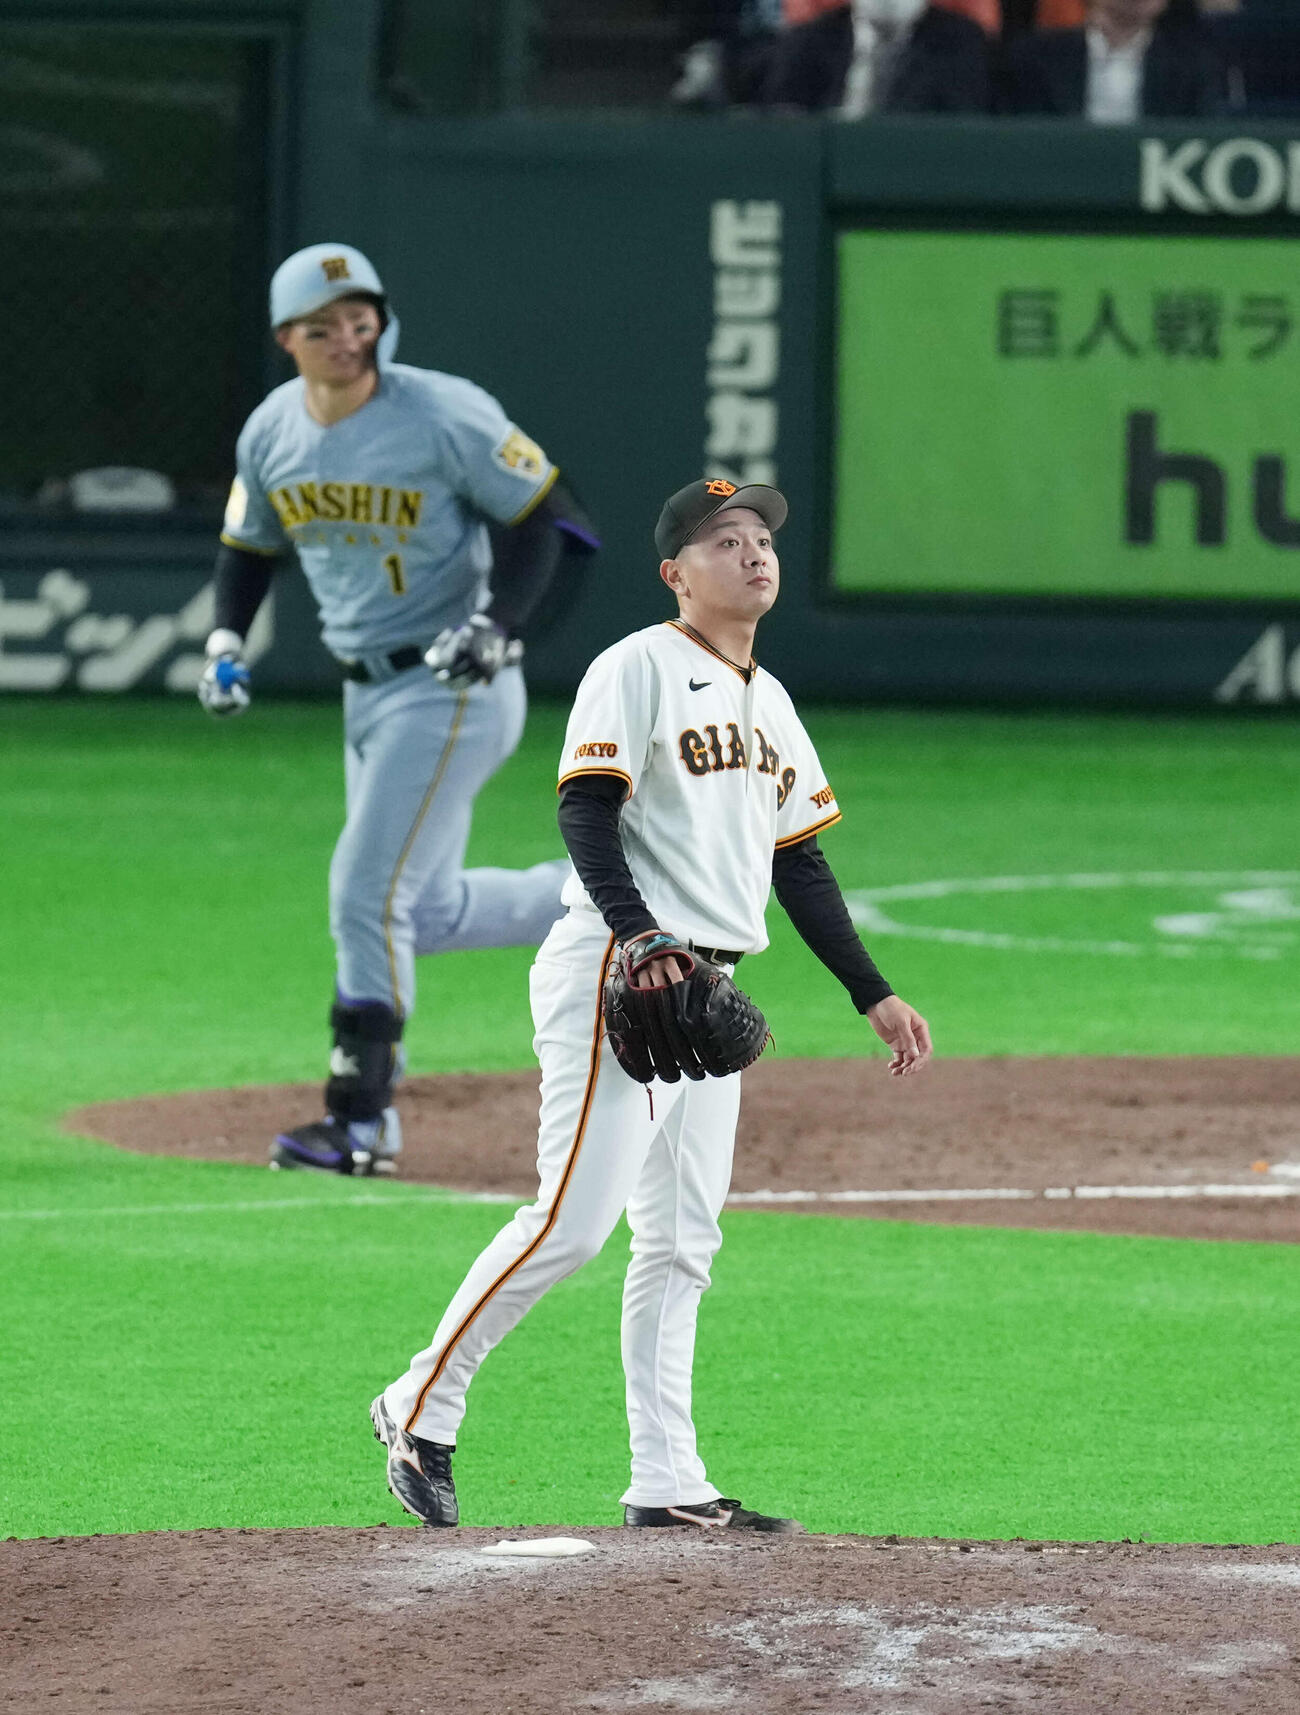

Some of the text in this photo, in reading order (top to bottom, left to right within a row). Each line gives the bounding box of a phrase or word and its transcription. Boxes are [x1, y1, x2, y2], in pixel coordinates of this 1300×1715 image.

[1140, 138, 1300, 215] KO
[268, 482, 423, 528] ANSHIN
[385, 553, 405, 596] 1
[1215, 622, 1300, 702] A
